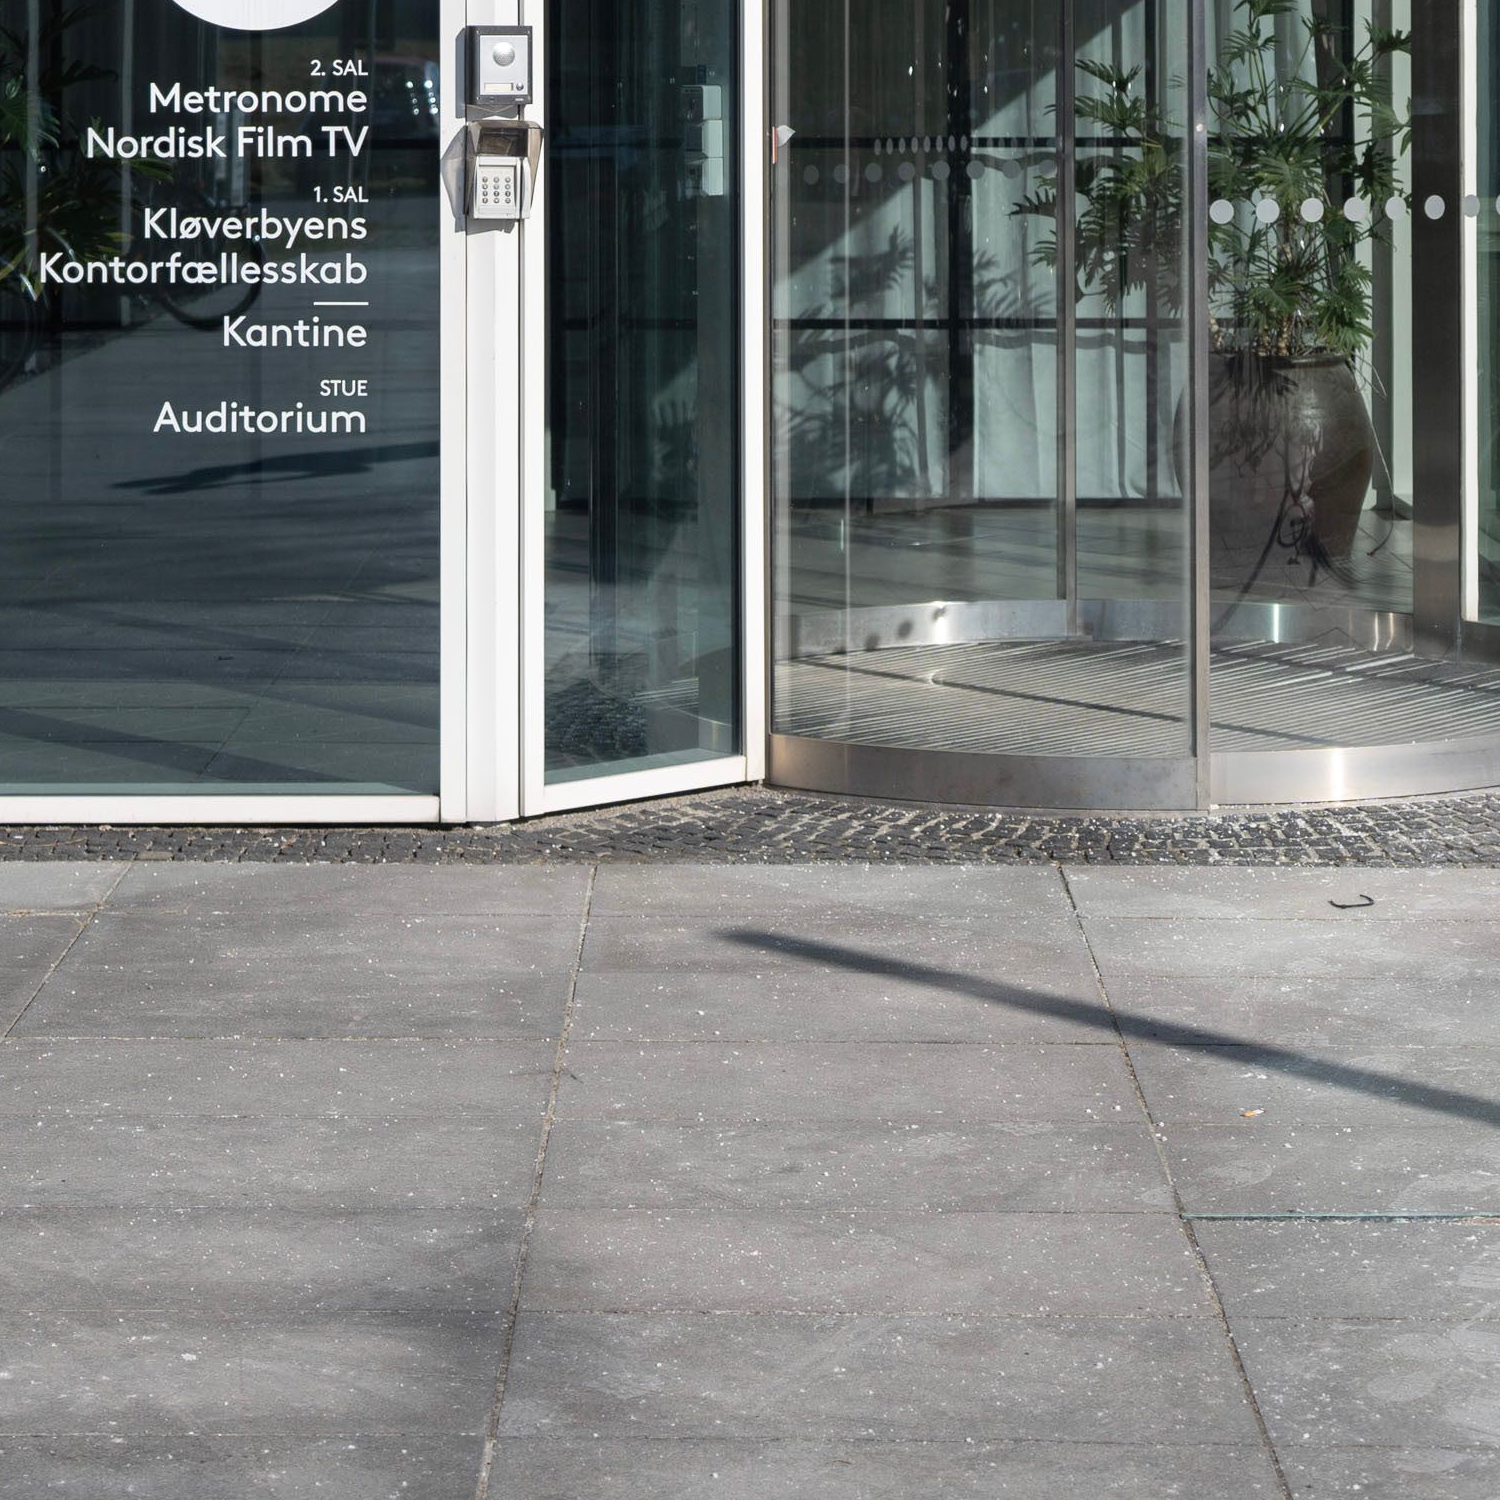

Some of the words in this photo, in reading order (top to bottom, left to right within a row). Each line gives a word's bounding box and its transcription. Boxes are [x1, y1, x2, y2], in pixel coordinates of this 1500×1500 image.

[310, 59, 326, 77] 2.
[332, 59, 369, 77] SAL
[149, 83, 368, 114] Metronome
[86, 126, 227, 159] Nordisk
[237, 125, 312, 158] Film
[321, 125, 369, 157] TV
[313, 185, 328, 204] 1.
[332, 185, 369, 204] SAL
[143, 207, 368, 249] Kløverbyens
[38, 252, 368, 285] Kontorfællesskab
[222, 316, 368, 348] Kantine
[319, 379, 369, 398] STUE
[152, 401, 367, 434] Auditorium
